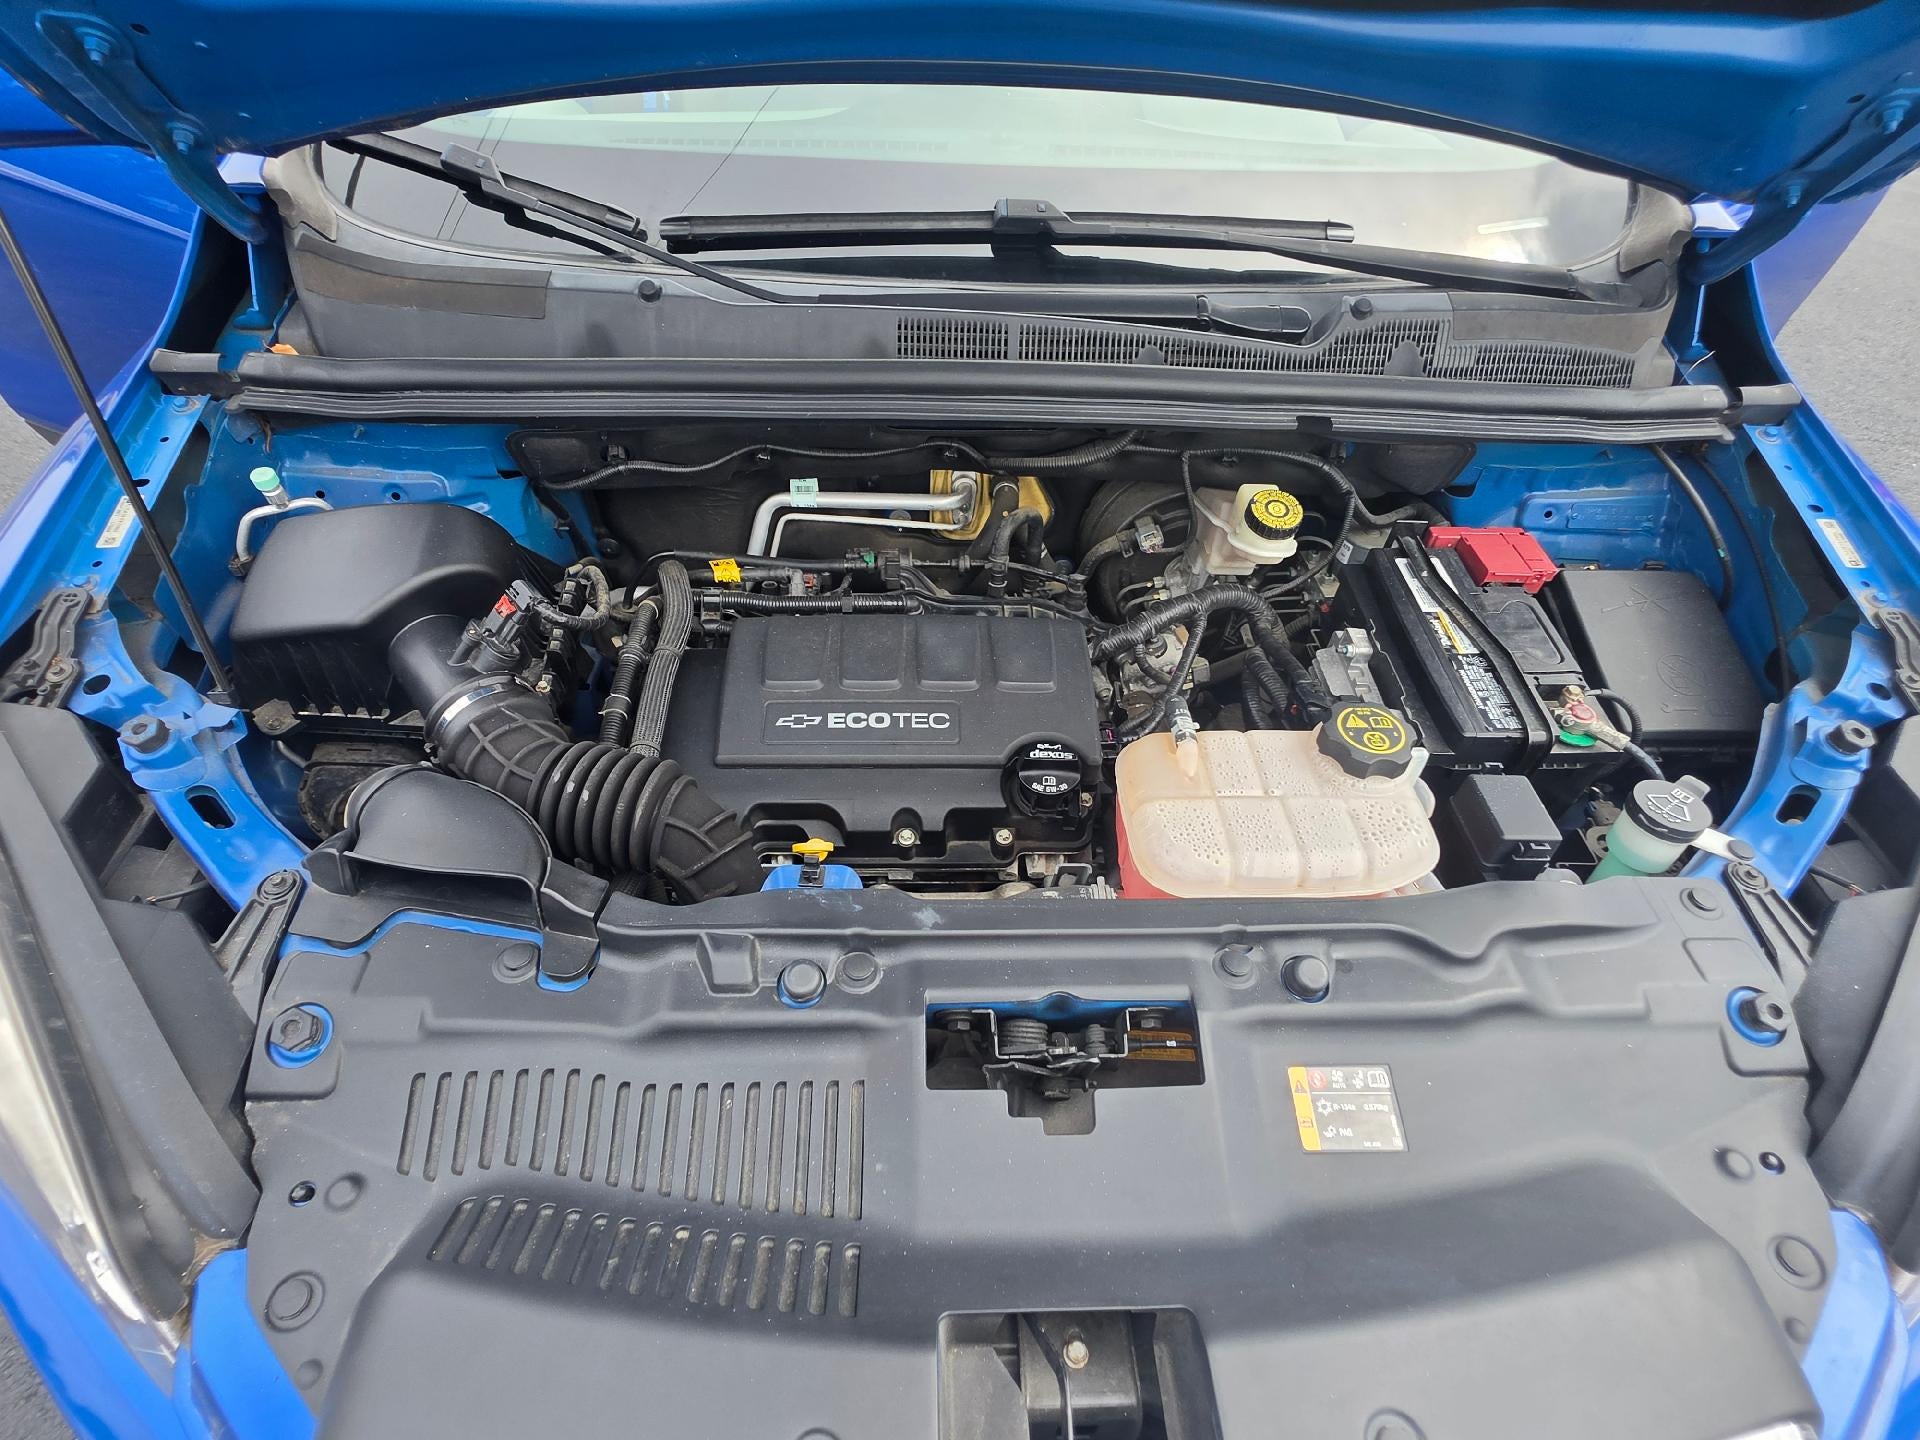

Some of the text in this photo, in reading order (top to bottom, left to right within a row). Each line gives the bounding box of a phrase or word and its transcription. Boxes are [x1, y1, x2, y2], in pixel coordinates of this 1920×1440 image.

[827, 712, 951, 729] ECOTEC
[1029, 749, 1075, 759] dexos
[1031, 782, 1045, 792] SAE
